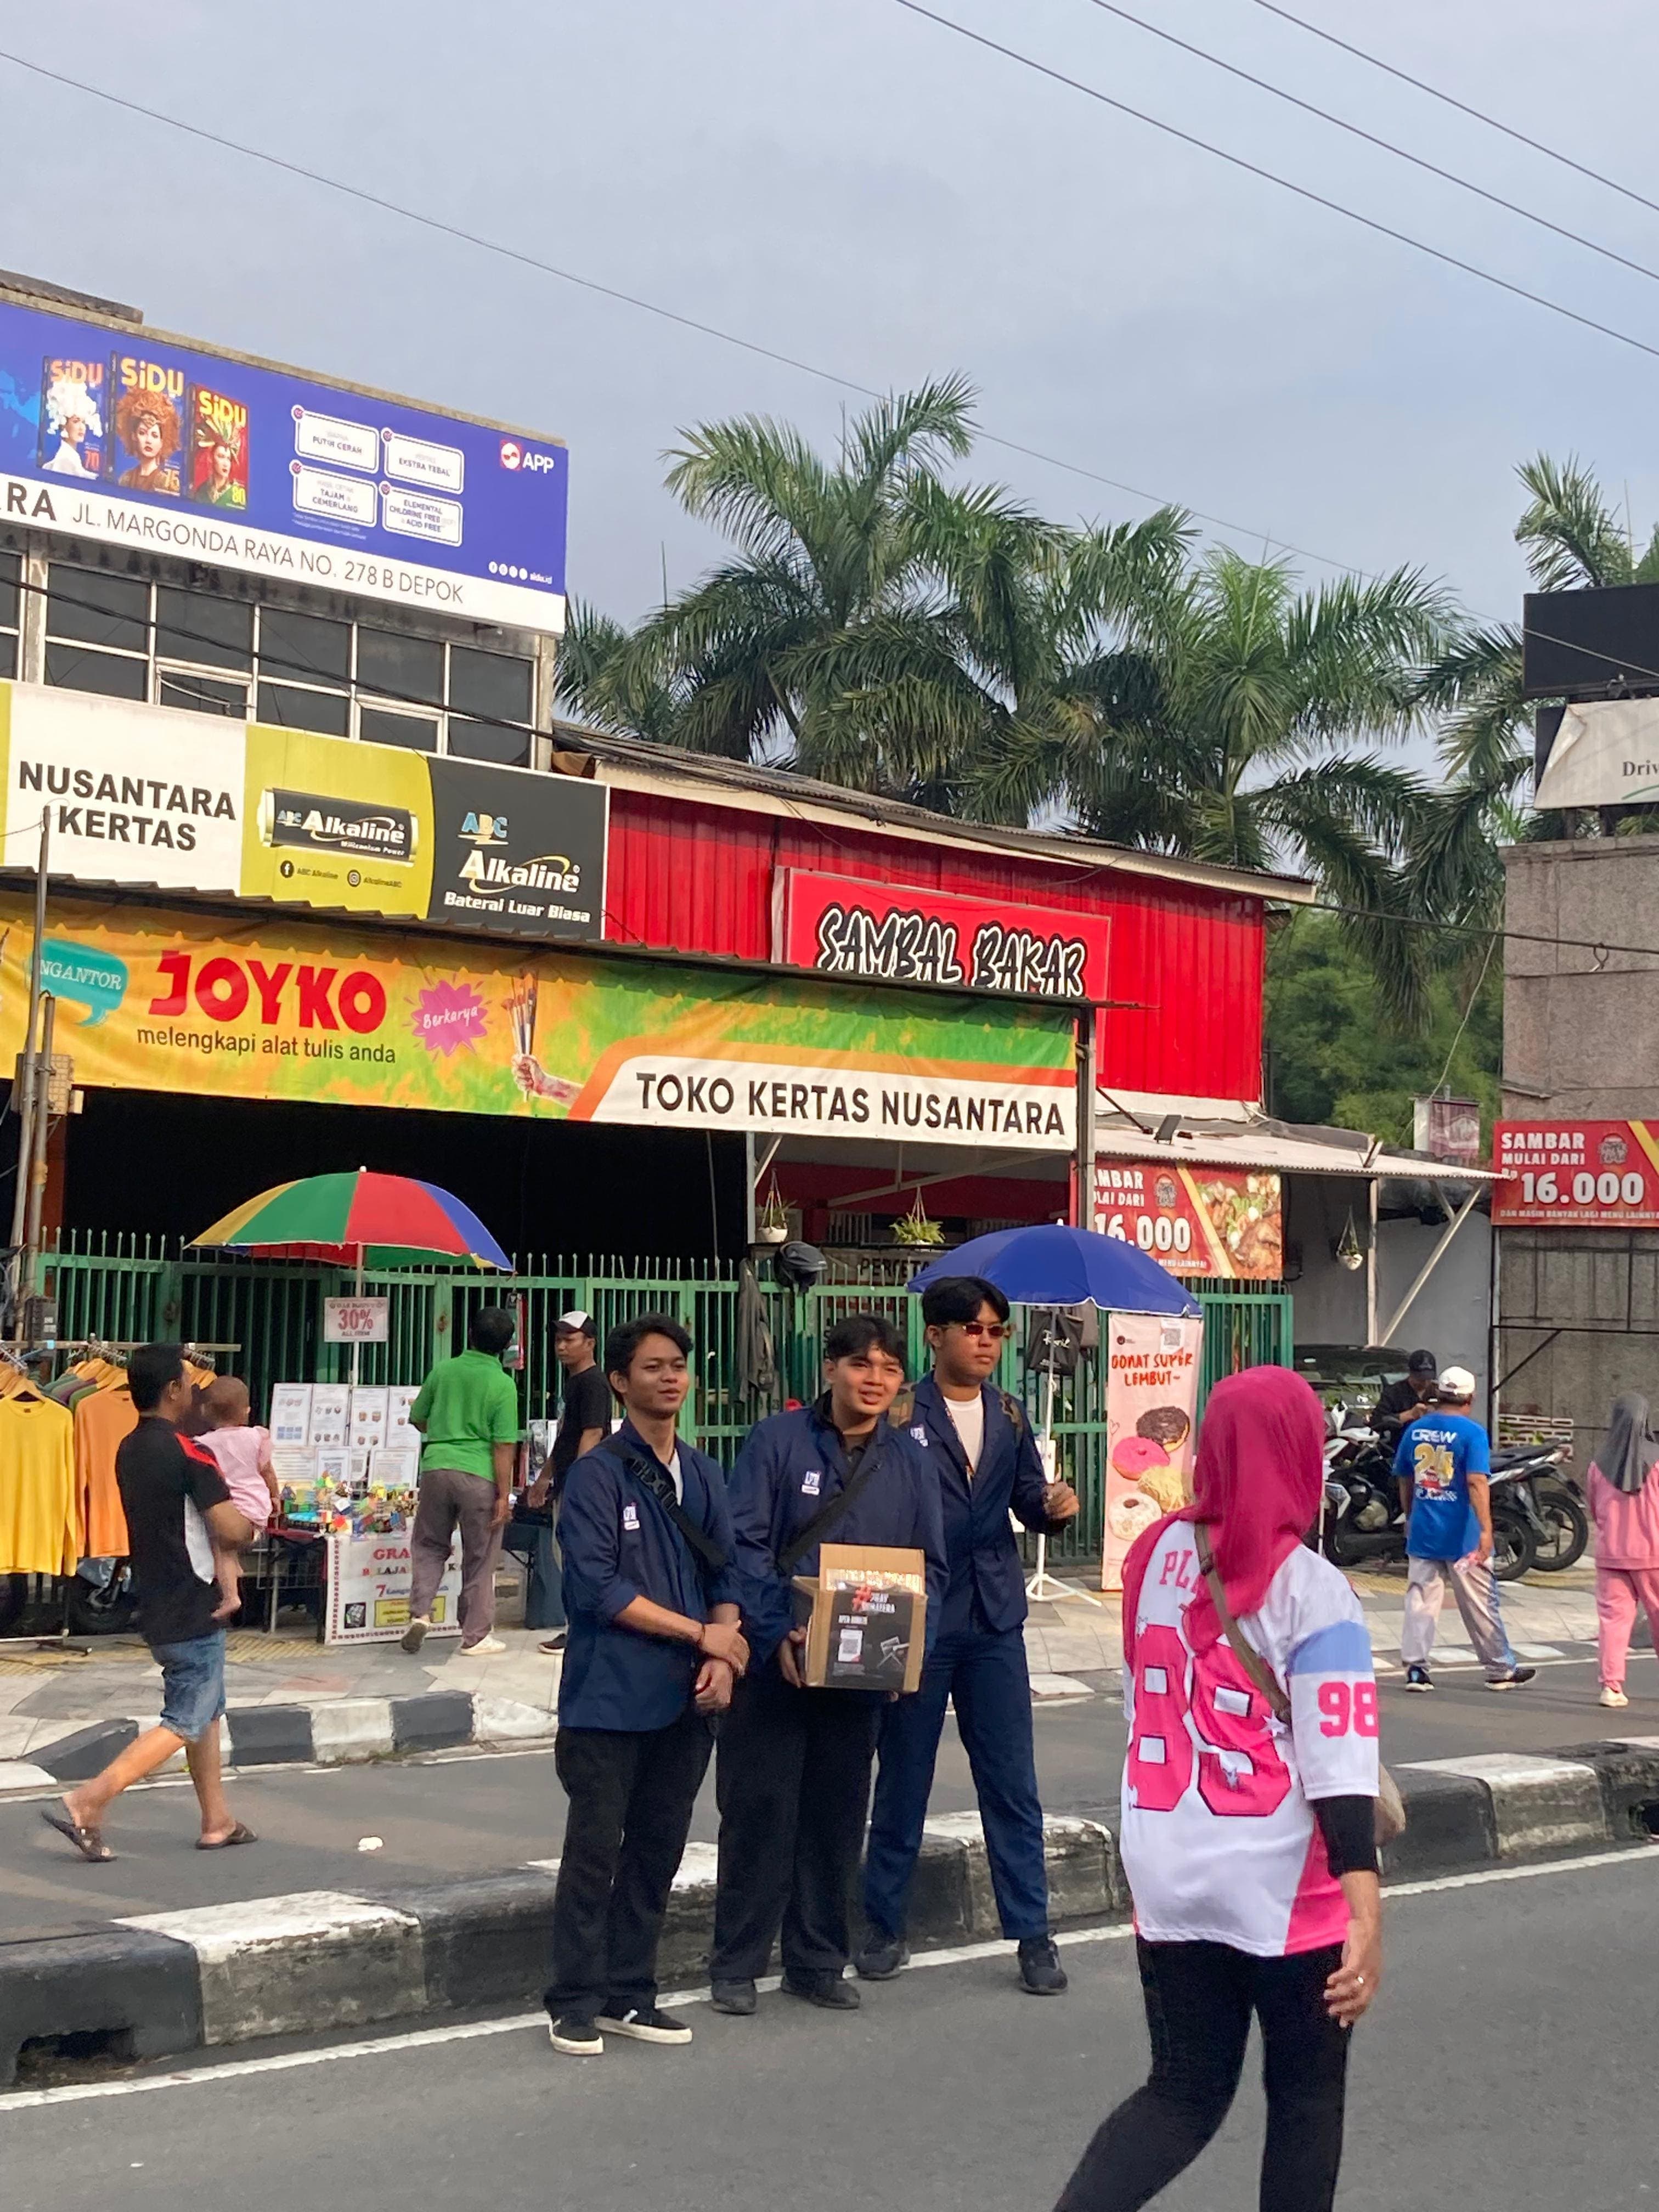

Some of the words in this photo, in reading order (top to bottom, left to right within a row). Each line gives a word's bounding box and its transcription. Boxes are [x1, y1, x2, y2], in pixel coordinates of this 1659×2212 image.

[121, 358, 184, 396] SiDU
[199, 391, 246, 426] SiDU
[399, 458, 426, 470] EKSTRA
[428, 464, 450, 477] TEBAL
[522, 452, 554, 474] APP
[312, 496, 358, 513] CEMERLANG
[320, 488, 345, 500] TAJAM
[403, 499, 442, 514] ELEMENTAL
[0, 482, 57, 522] RA
[72, 503, 100, 527] JL.
[107, 509, 239, 556] MARGONDA
[245, 539, 294, 568] RAYA
[300, 550, 337, 578] NO.
[345, 561, 377, 585] 278
[383, 569, 394, 589] B
[400, 572, 464, 603] DEPOK
[19, 760, 236, 821] NUSANTARA
[58, 805, 196, 851] KERTAS
[276, 809, 302, 824] ABC
[301, 810, 405, 844] Alkaline
[461, 812, 508, 839] ABC
[459, 849, 580, 893] Alkaline
[508, 901, 544, 916] Luar
[816, 905, 963, 984] SAMBAL
[972, 924, 1087, 998] BAKAR
[148, 950, 387, 1034] JOYKO
[422, 1005, 478, 1030] Berkarya
[137, 1026, 256, 1054] melengkapi
[262, 1035, 297, 1056] alat
[304, 1040, 343, 1059] tulis
[349, 1043, 396, 1063] anda
[636, 1072, 734, 1114] TOKO
[748, 1080, 870, 1123] KERTAS
[881, 1091, 1065, 1136] NUSANTARA
[1501, 1132, 1584, 1150] SAMBAR
[1501, 1153, 1547, 1166] MULAI
[1550, 1153, 1585, 1166] DARI
[1118, 1192, 1145, 1207] DARI
[1521, 1172, 1644, 1205] 16.000
[1094, 1213, 1191, 1253] 16.000
[338, 1308, 374, 1330] 30%
[1111, 1353, 1149, 1369] DONAT
[1411, 1429, 1457, 1443] CREW
[373, 1547, 411, 1561] GRA
[1159, 1549, 1198, 1594] PL
[375, 1584, 386, 1597] 7
[1318, 1681, 1379, 1737] 98
